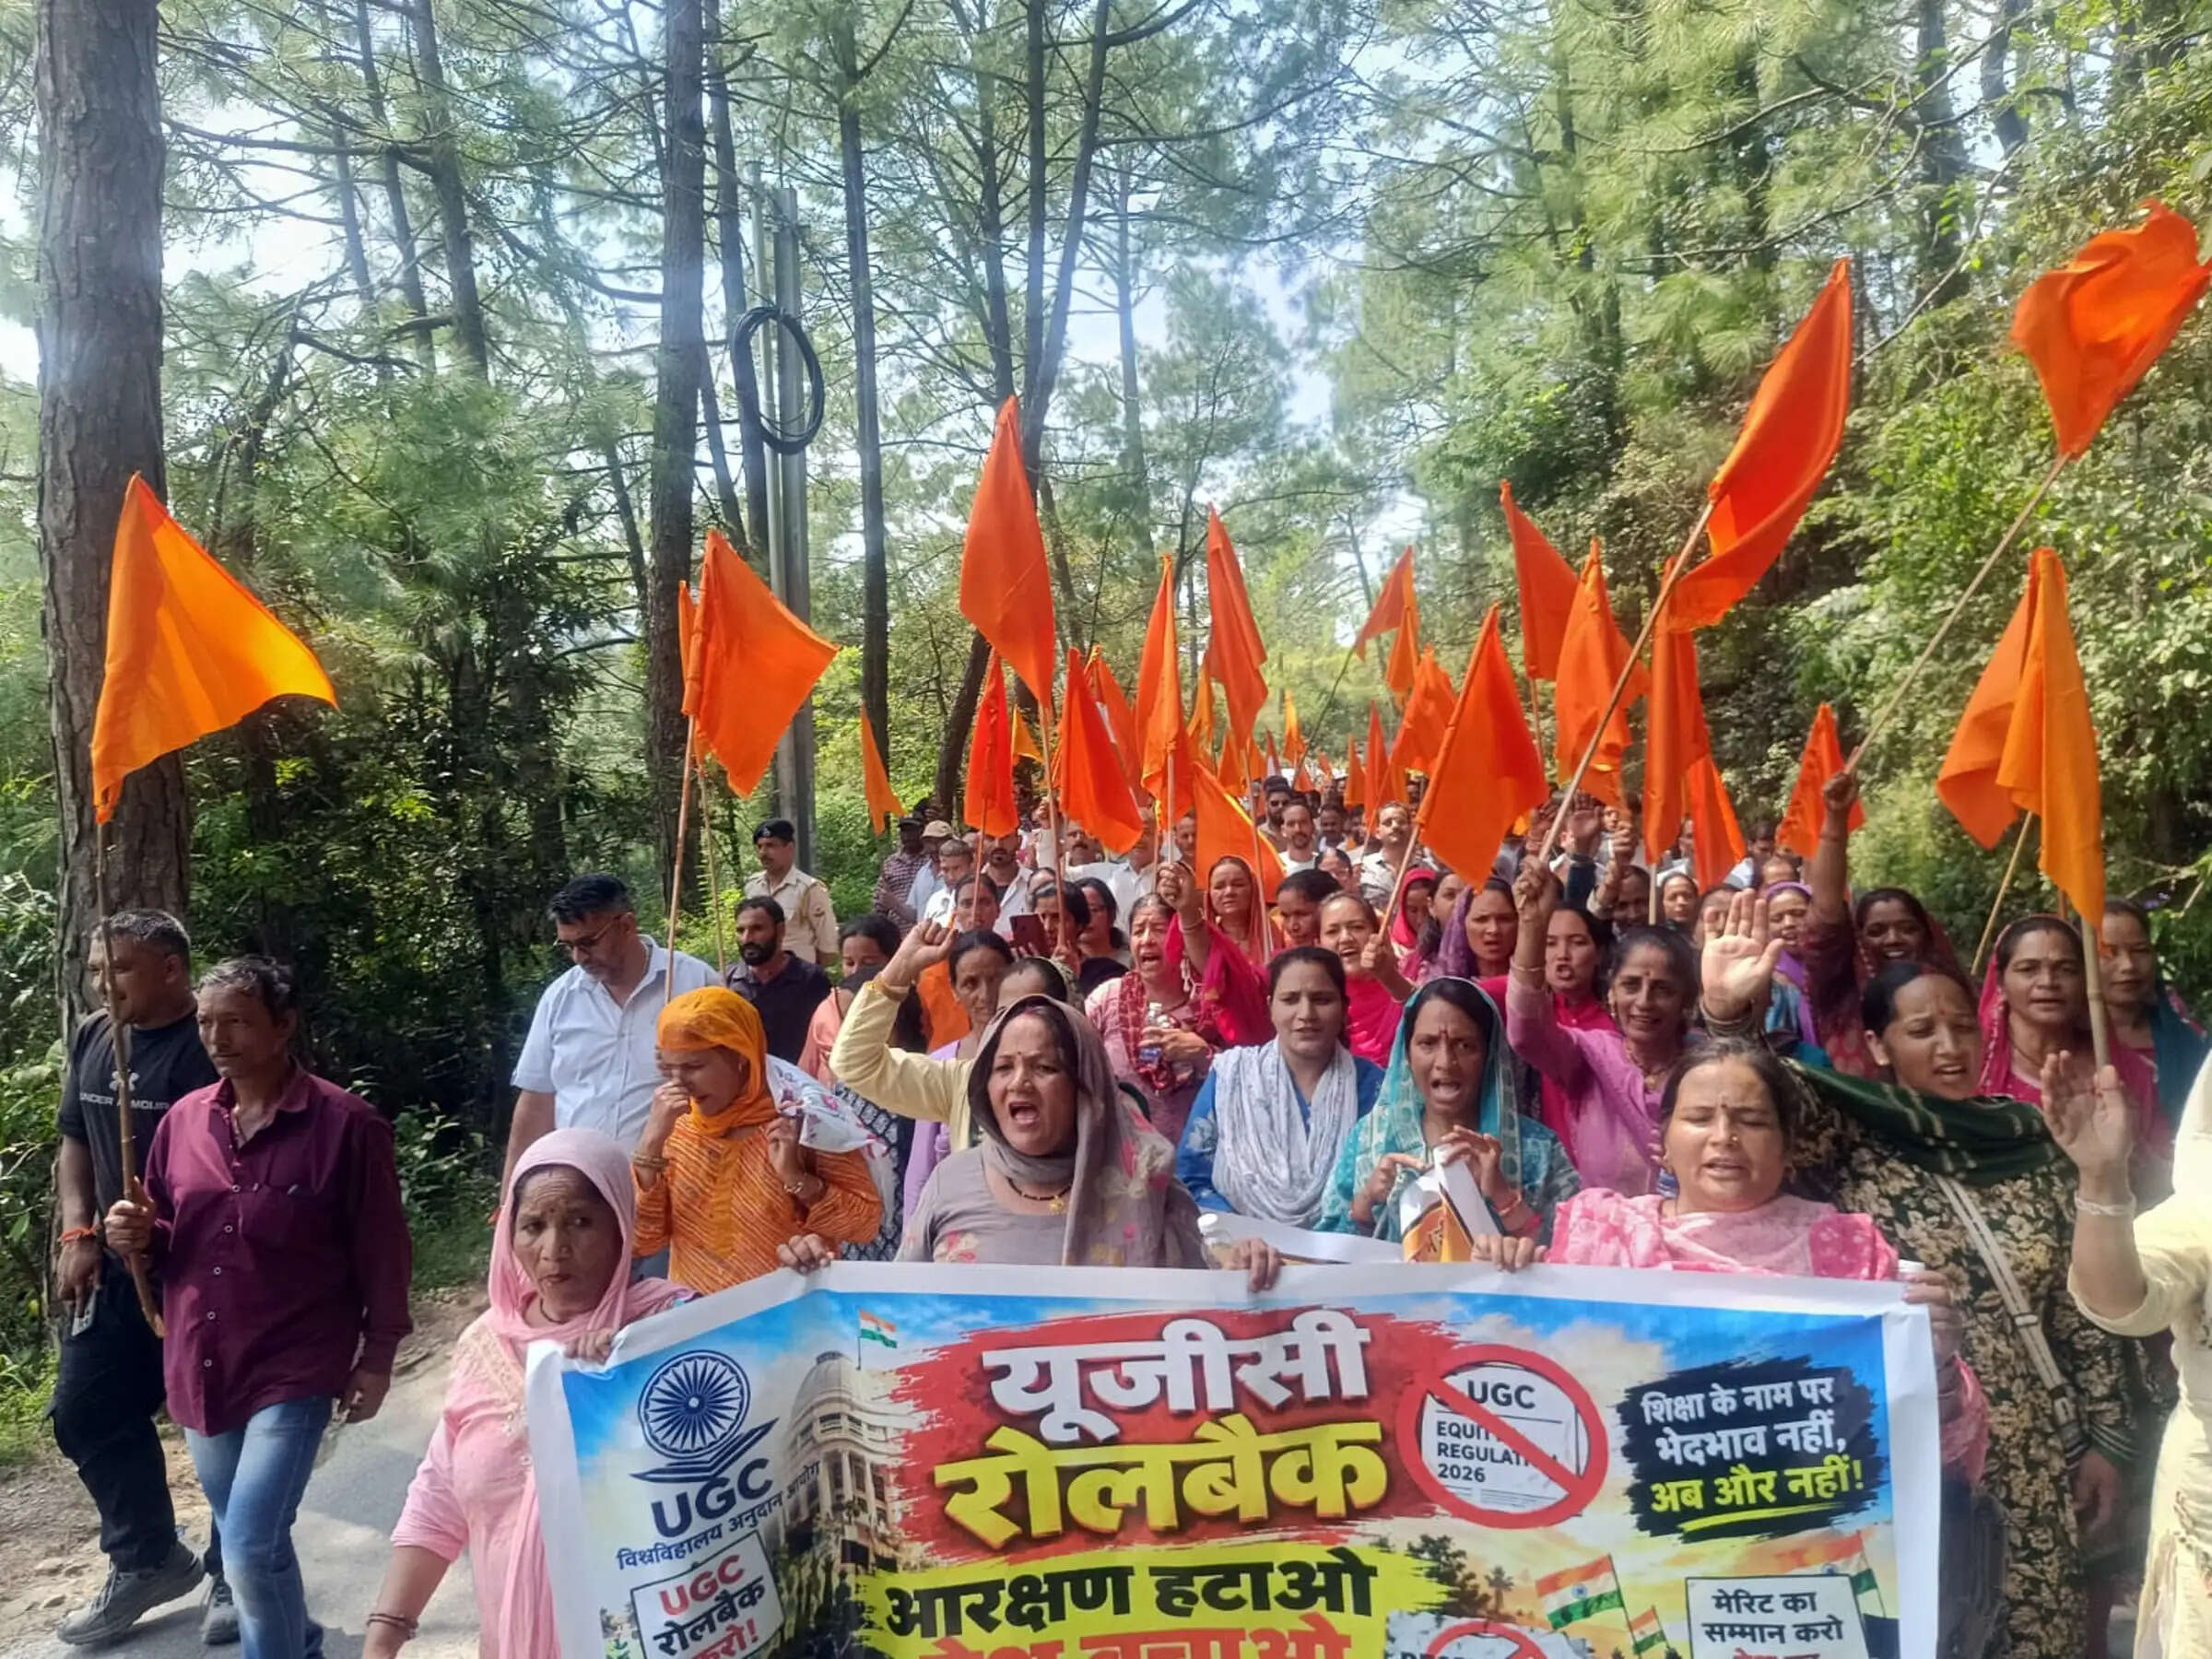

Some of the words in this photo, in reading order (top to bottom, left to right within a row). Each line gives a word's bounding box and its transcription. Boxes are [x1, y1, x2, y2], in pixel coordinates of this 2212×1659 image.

[982, 1309, 1371, 1443] यूजीसी
[1467, 1380, 1535, 1410] UGC
[1641, 1391, 1705, 1425] शिक्षा
[1711, 1382, 1737, 1416] के
[1742, 1381, 1794, 1411] नाम
[1797, 1377, 1835, 1405] पर
[1436, 1420, 1501, 1442] EQUIT
[1655, 1426, 1767, 1465] भेदभाव
[1773, 1409, 1846, 1453] नहीं,
[651, 1458, 773, 1538] UGC
[935, 1413, 1388, 1550] रोलबैक
[1437, 1463, 1486, 1483] 2026
[1651, 1479, 1703, 1512] अब
[1713, 1464, 1777, 1504] और
[1783, 1453, 1865, 1499] नहीं!
[728, 1495, 783, 1528] अनुदान
[659, 1555, 745, 1616] UGC
[885, 1566, 1135, 1638] आरक्षण
[1149, 1547, 1378, 1617] हटाओ
[1712, 1589, 1774, 1613] मेरिट
[1779, 1592, 1817, 1612] का
[653, 1576, 765, 1656] रोलबैक
[1702, 1622, 1785, 1644] सम्मान
[1793, 1615, 1843, 1642] करो
